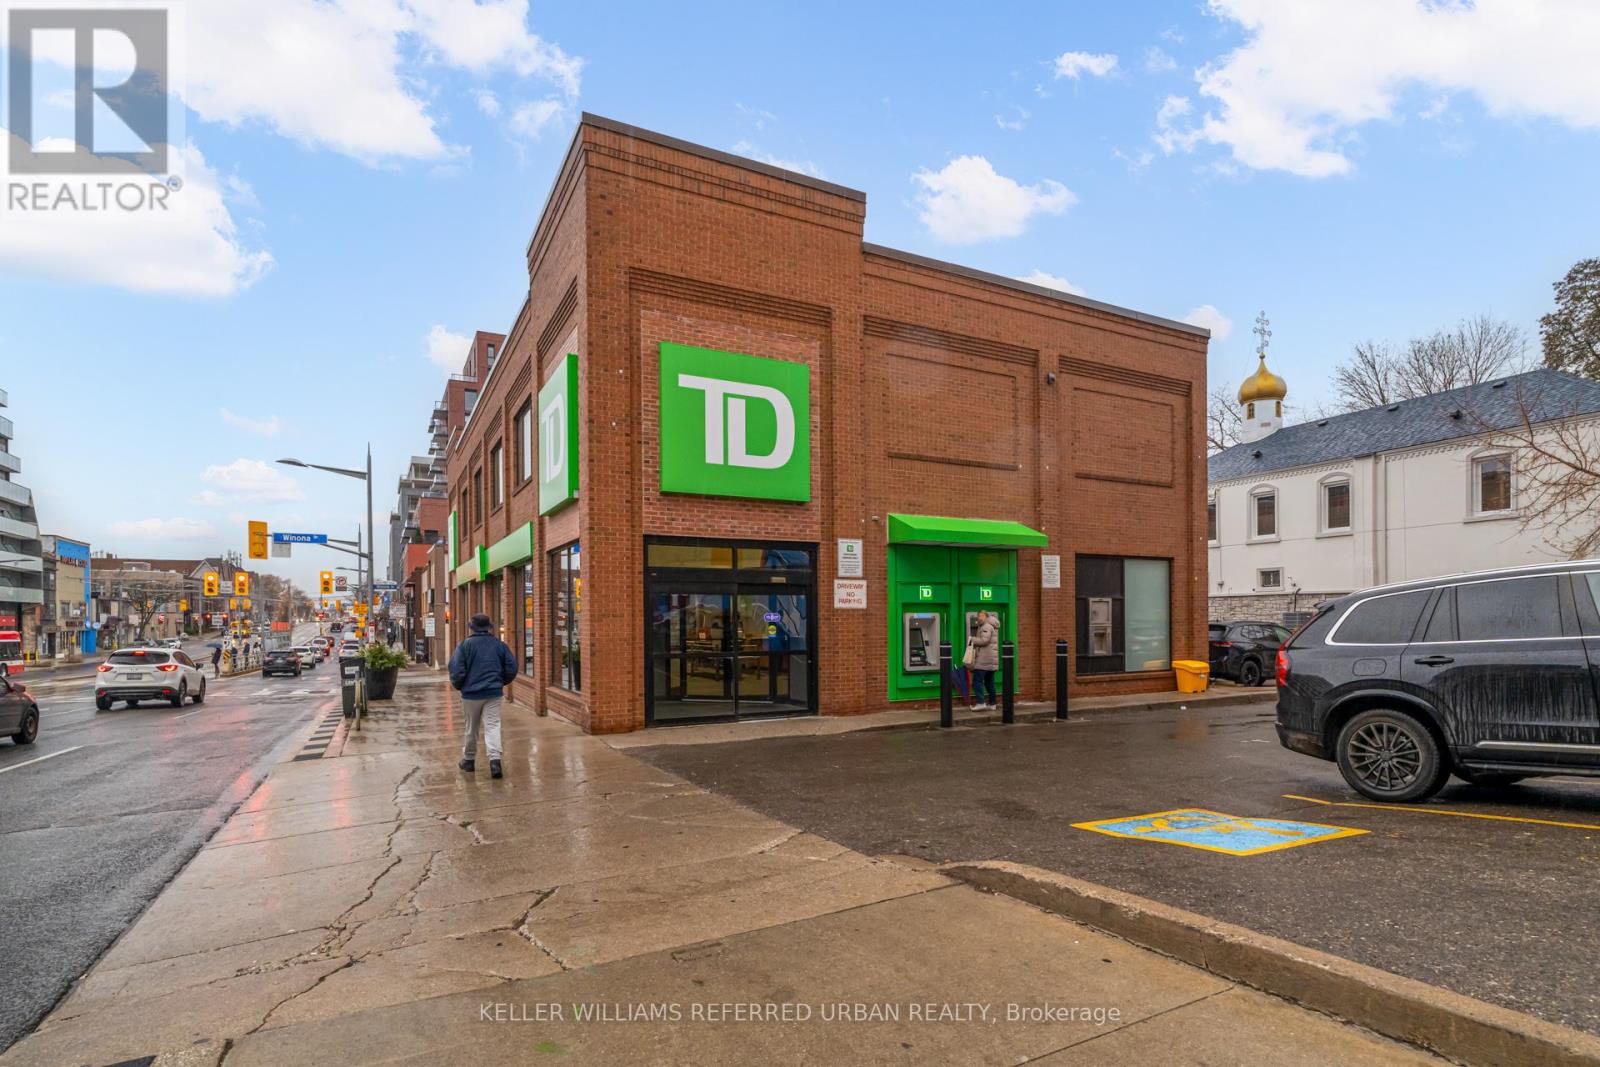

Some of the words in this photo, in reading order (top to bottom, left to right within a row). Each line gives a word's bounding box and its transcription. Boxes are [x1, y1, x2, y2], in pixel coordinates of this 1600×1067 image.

[678, 373, 796, 470] TD
[541, 393, 565, 485] TD
[282, 533, 312, 543] Winona
[921, 588, 932, 598] TD
[981, 589, 992, 598] TD
